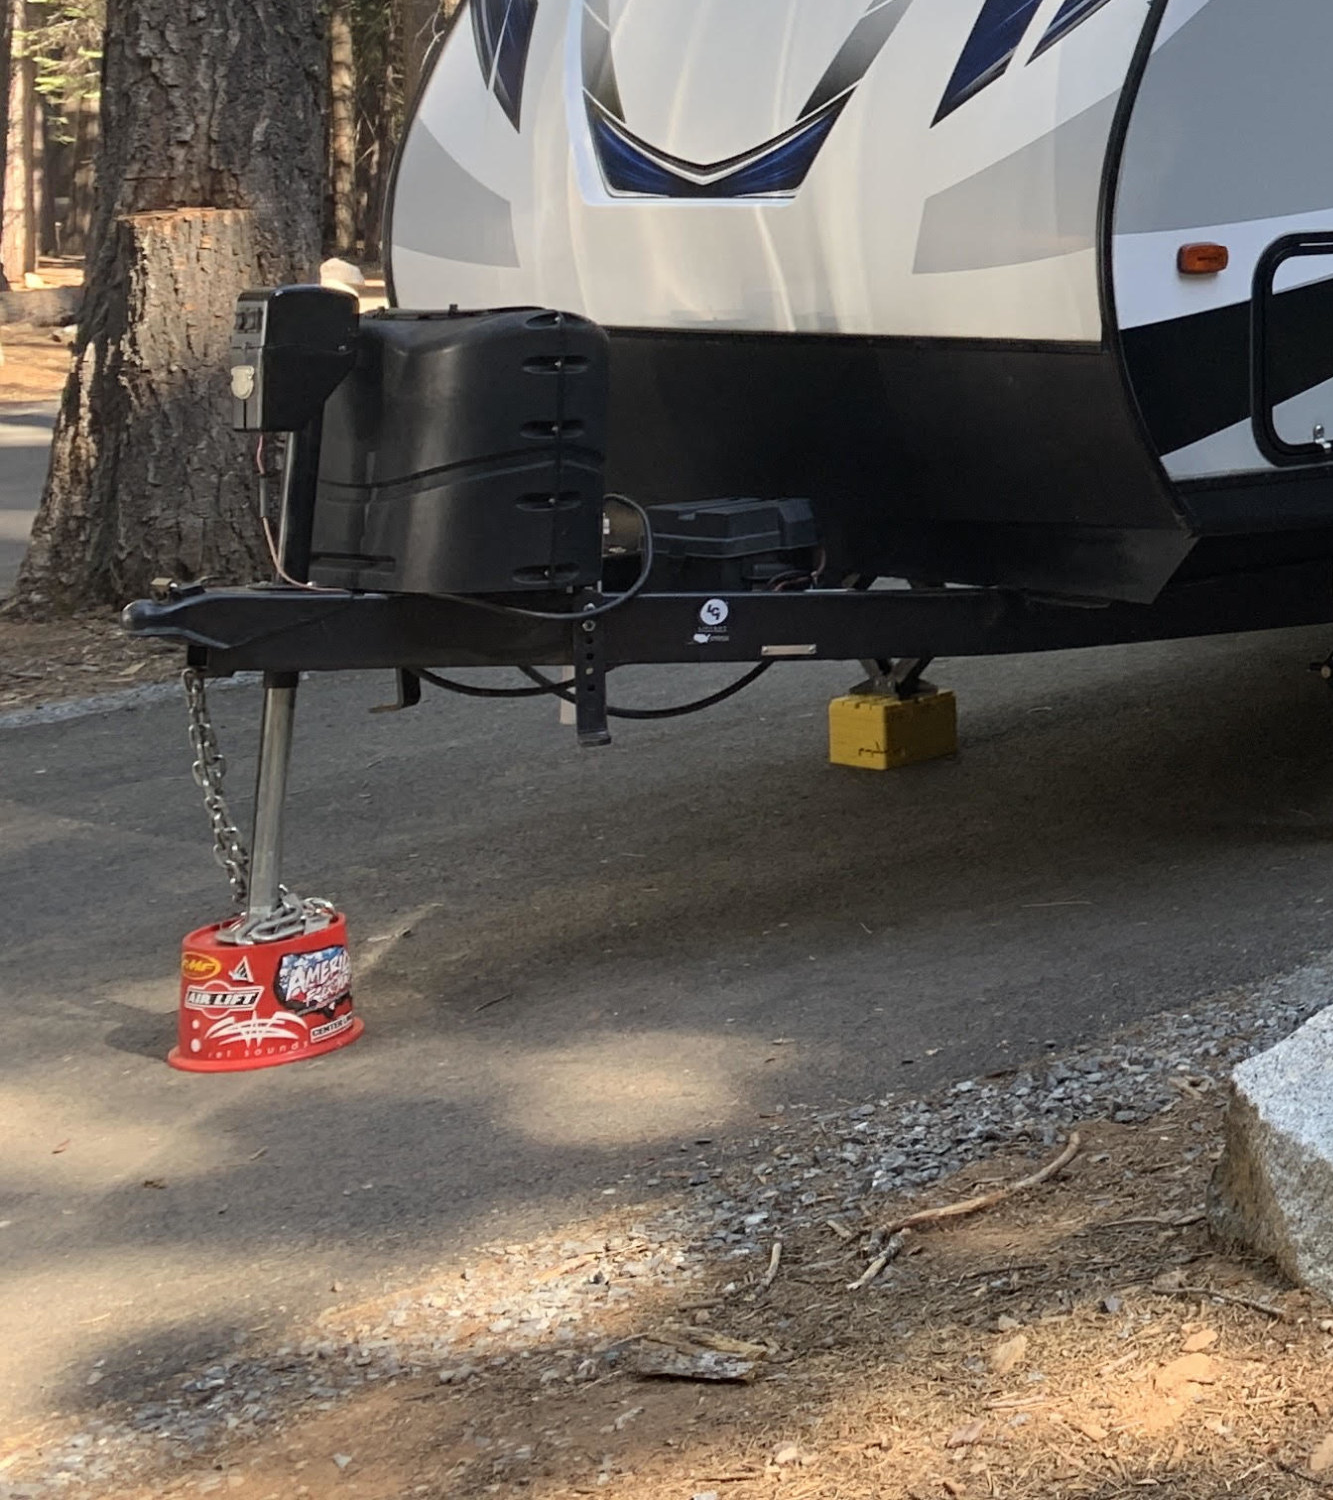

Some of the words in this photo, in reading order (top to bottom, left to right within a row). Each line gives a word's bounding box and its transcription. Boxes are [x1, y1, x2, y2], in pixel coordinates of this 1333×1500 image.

[188, 992, 211, 1005] AIR
[214, 993, 256, 1005] LIFT
[312, 1020, 343, 1037] CENTER
